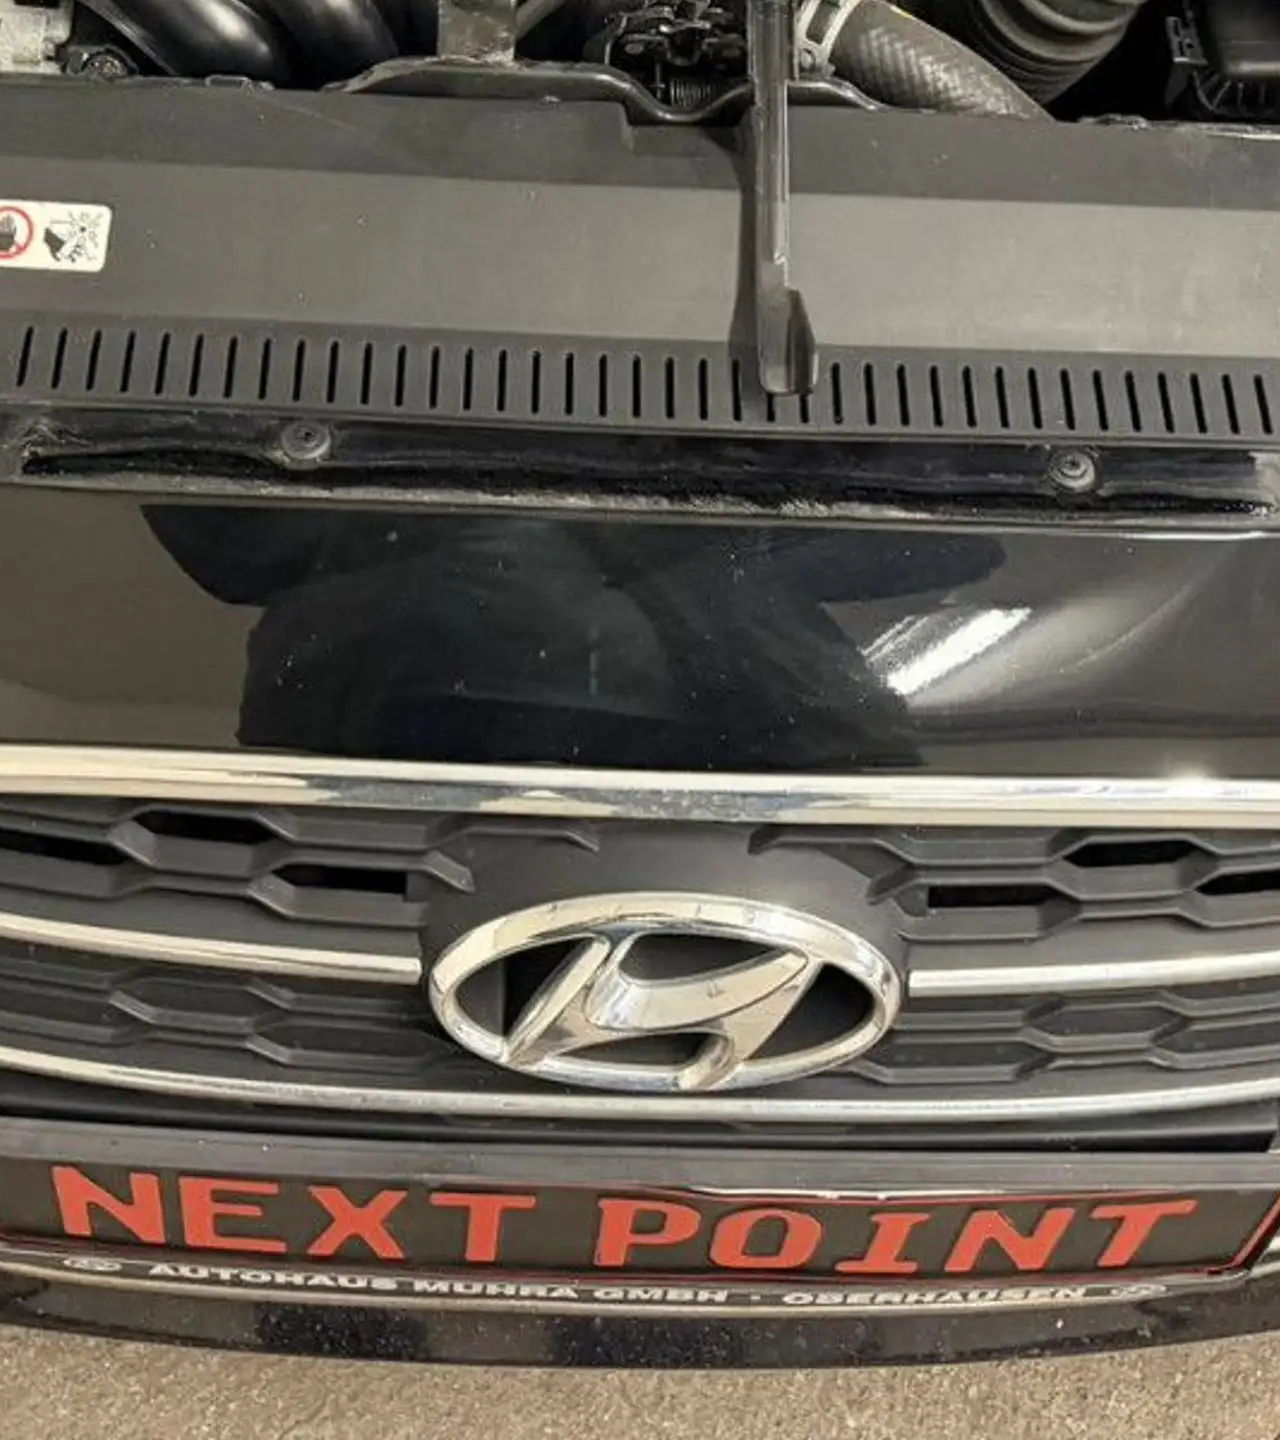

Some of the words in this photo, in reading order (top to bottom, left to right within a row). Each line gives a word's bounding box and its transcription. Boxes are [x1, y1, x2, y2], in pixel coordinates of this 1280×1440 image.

[51, 1165, 536, 1263] NEXT
[592, 1197, 1198, 1274] POINT
[148, 1262, 400, 1291] AUTOHAUS
[593, 1286, 729, 1304] GMBH
[782, 1284, 1089, 1306] OBERHAUSEN
